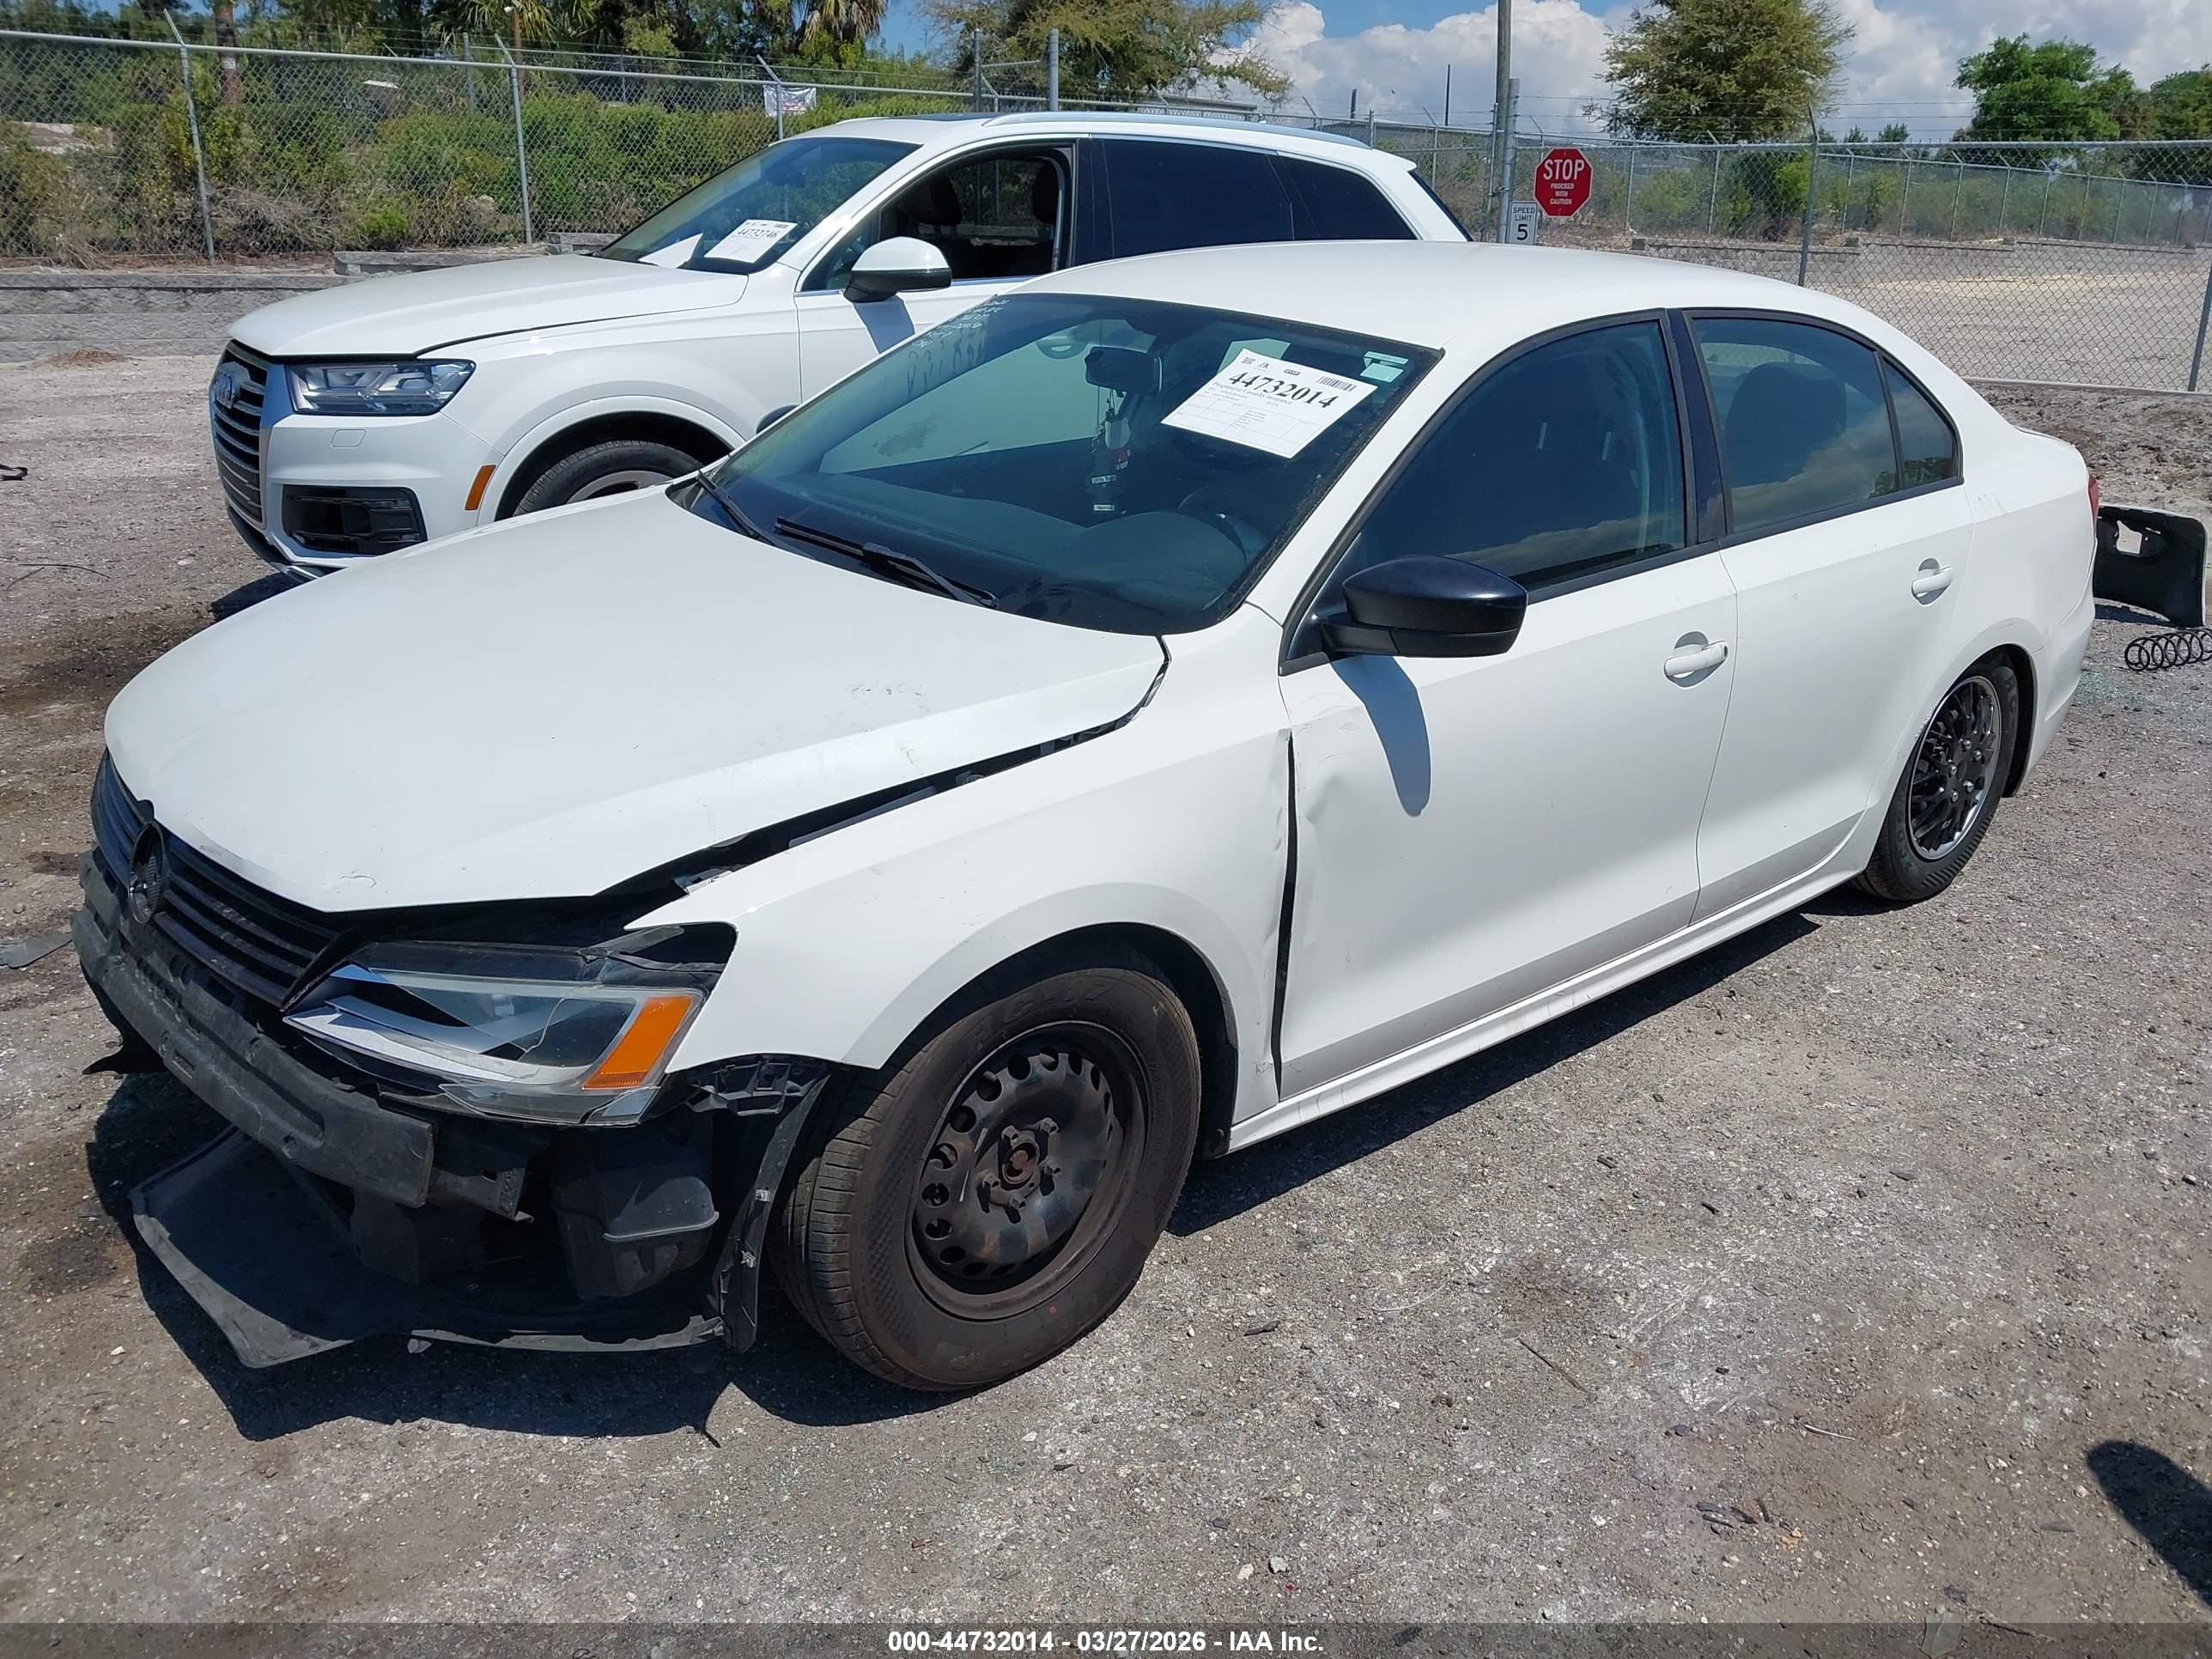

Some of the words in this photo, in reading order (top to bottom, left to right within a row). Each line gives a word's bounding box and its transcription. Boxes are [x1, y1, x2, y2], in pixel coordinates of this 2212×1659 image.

[1543, 159, 1584, 180] STOP
[1516, 224, 1528, 240] 5
[1228, 372, 1340, 409] 44732014
